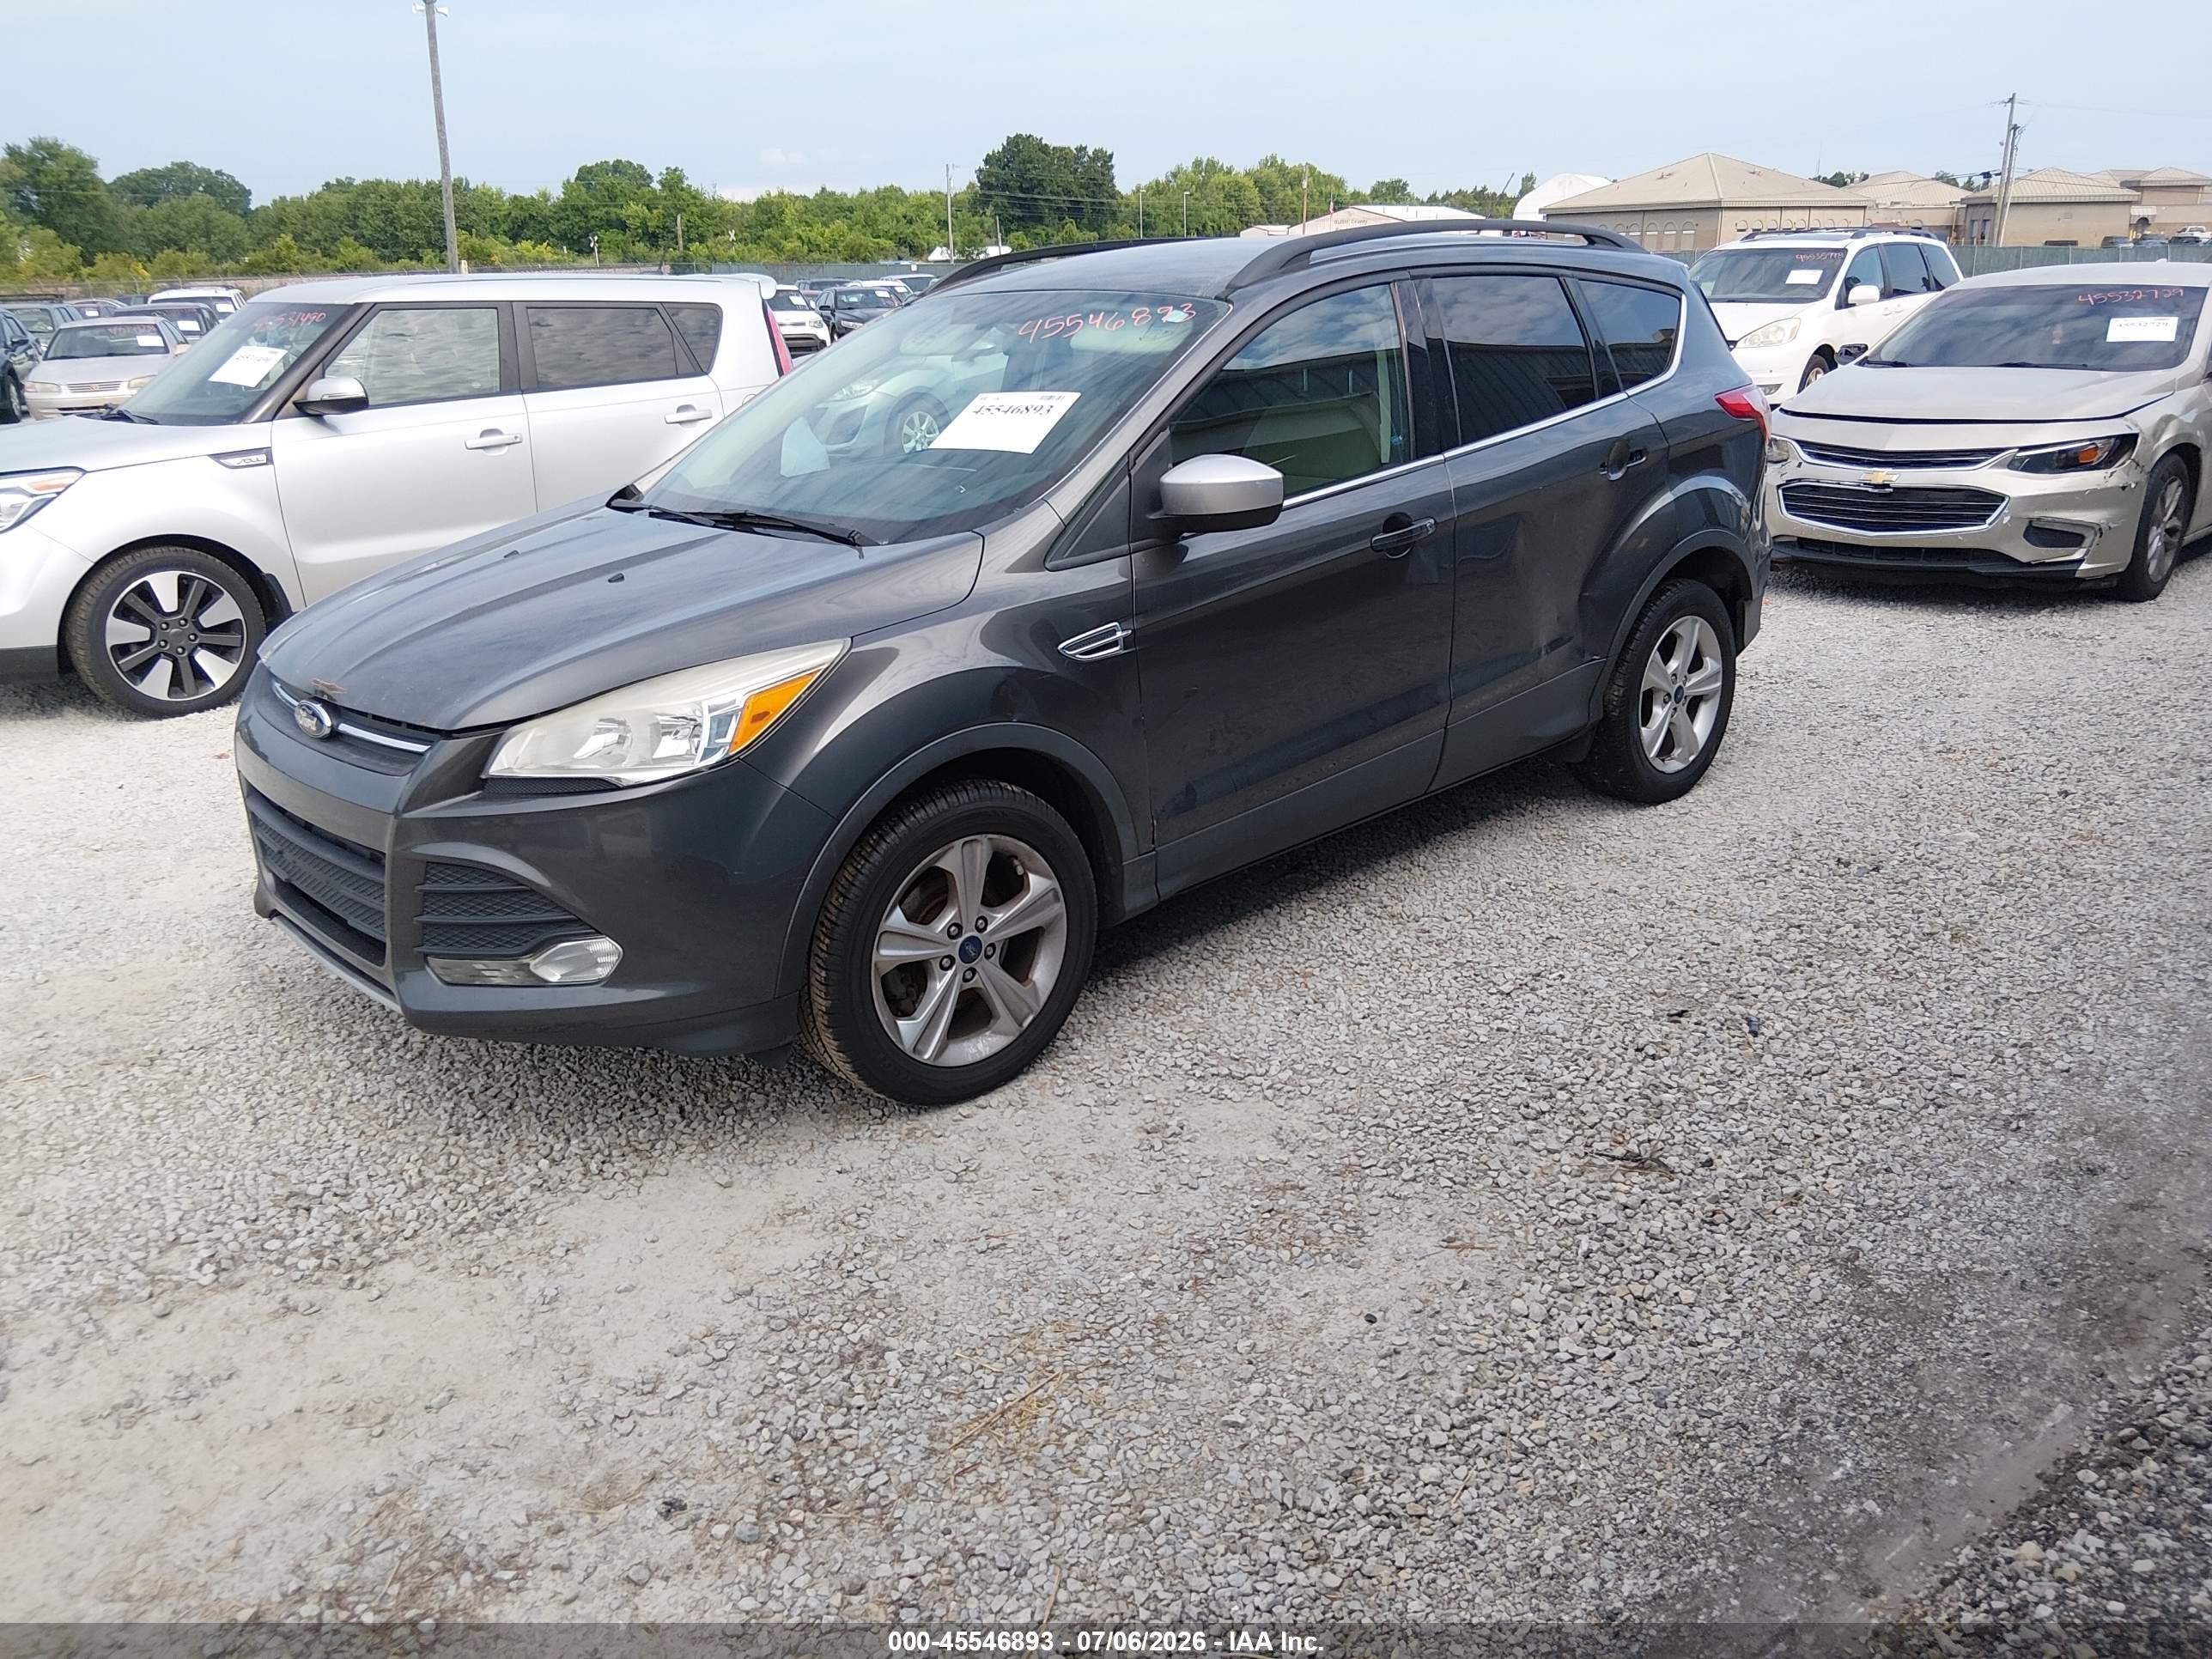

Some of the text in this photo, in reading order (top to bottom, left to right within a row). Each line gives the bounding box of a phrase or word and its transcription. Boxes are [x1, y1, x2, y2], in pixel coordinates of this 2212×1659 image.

[2078, 288, 2184, 306] 45532729
[1018, 302, 1196, 344] 45546893
[972, 404, 1054, 416] 45546893
